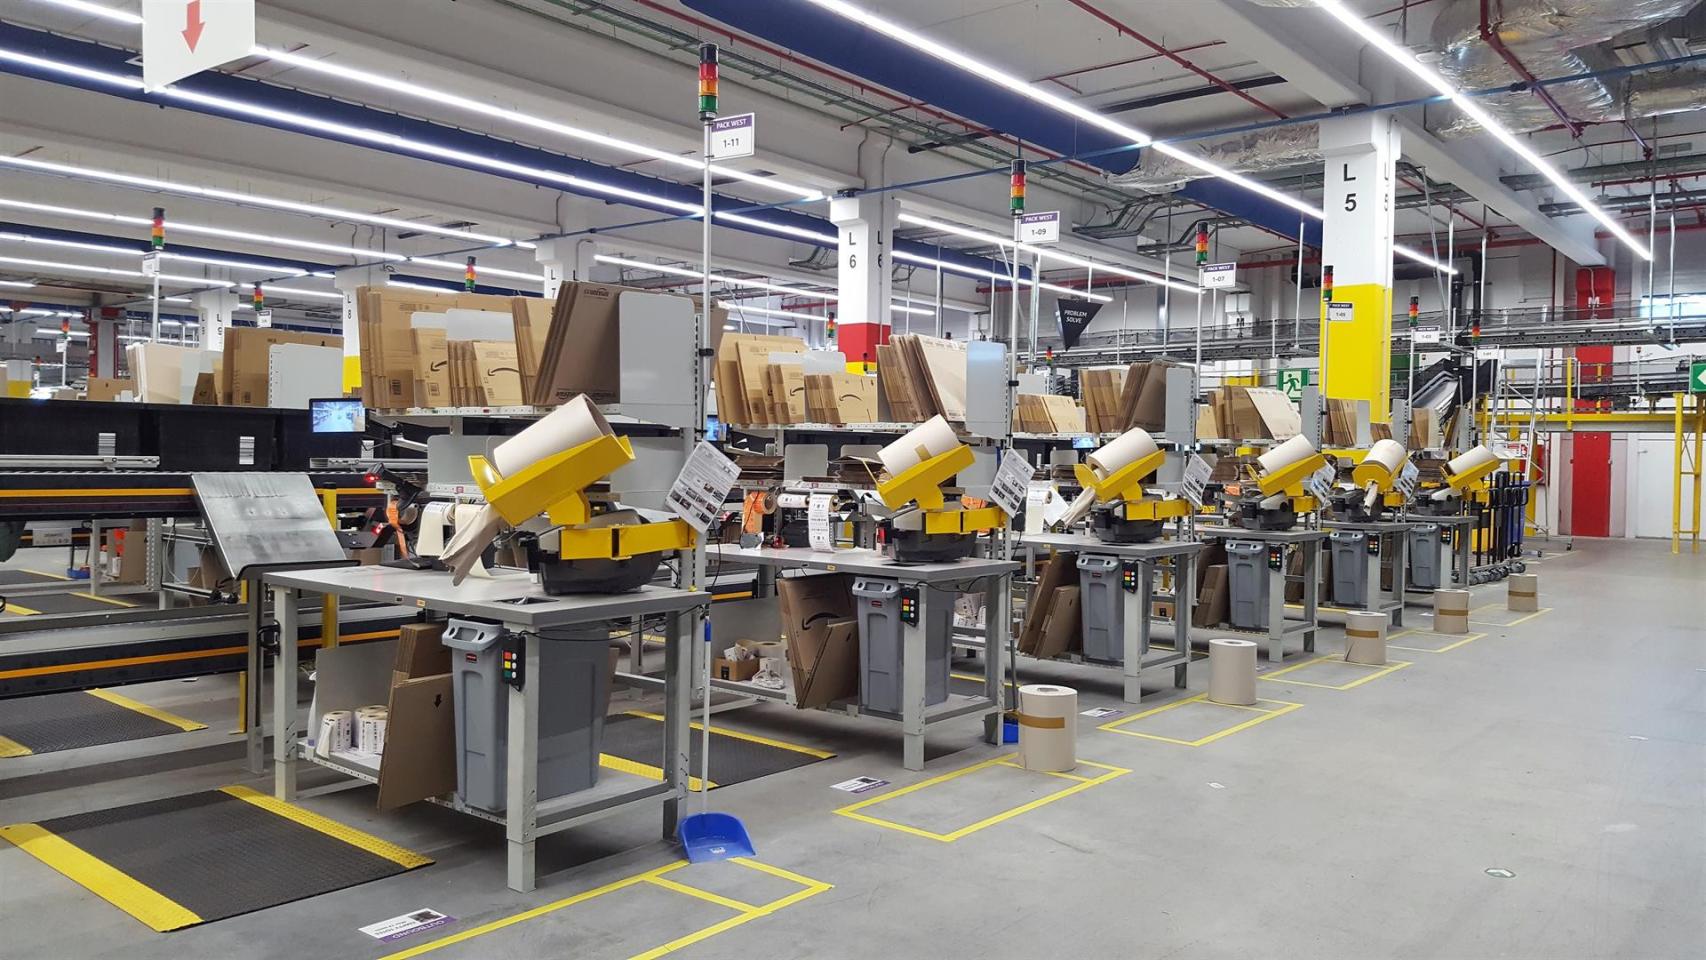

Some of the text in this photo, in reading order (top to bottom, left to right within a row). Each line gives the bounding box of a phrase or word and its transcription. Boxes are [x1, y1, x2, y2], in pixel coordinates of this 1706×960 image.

[716, 118, 747, 130] PACK WEST
[723, 138, 740, 148] 1-11
[1343, 163, 1357, 182] L
[1344, 193, 1357, 212] 5
[877, 230, 883, 245] L
[1032, 228, 1046, 236] 1-09
[849, 232, 856, 246] L
[849, 254, 857, 268] 6
[551, 270, 556, 281] L
[347, 295, 352, 304] L
[1588, 296, 1600, 308] M
[347, 309, 352, 319] 8
[1064, 309, 1088, 318] PROBLEM
[1066, 316, 1082, 324] SOLVE
[392, 920, 445, 939] OUTBOUND
